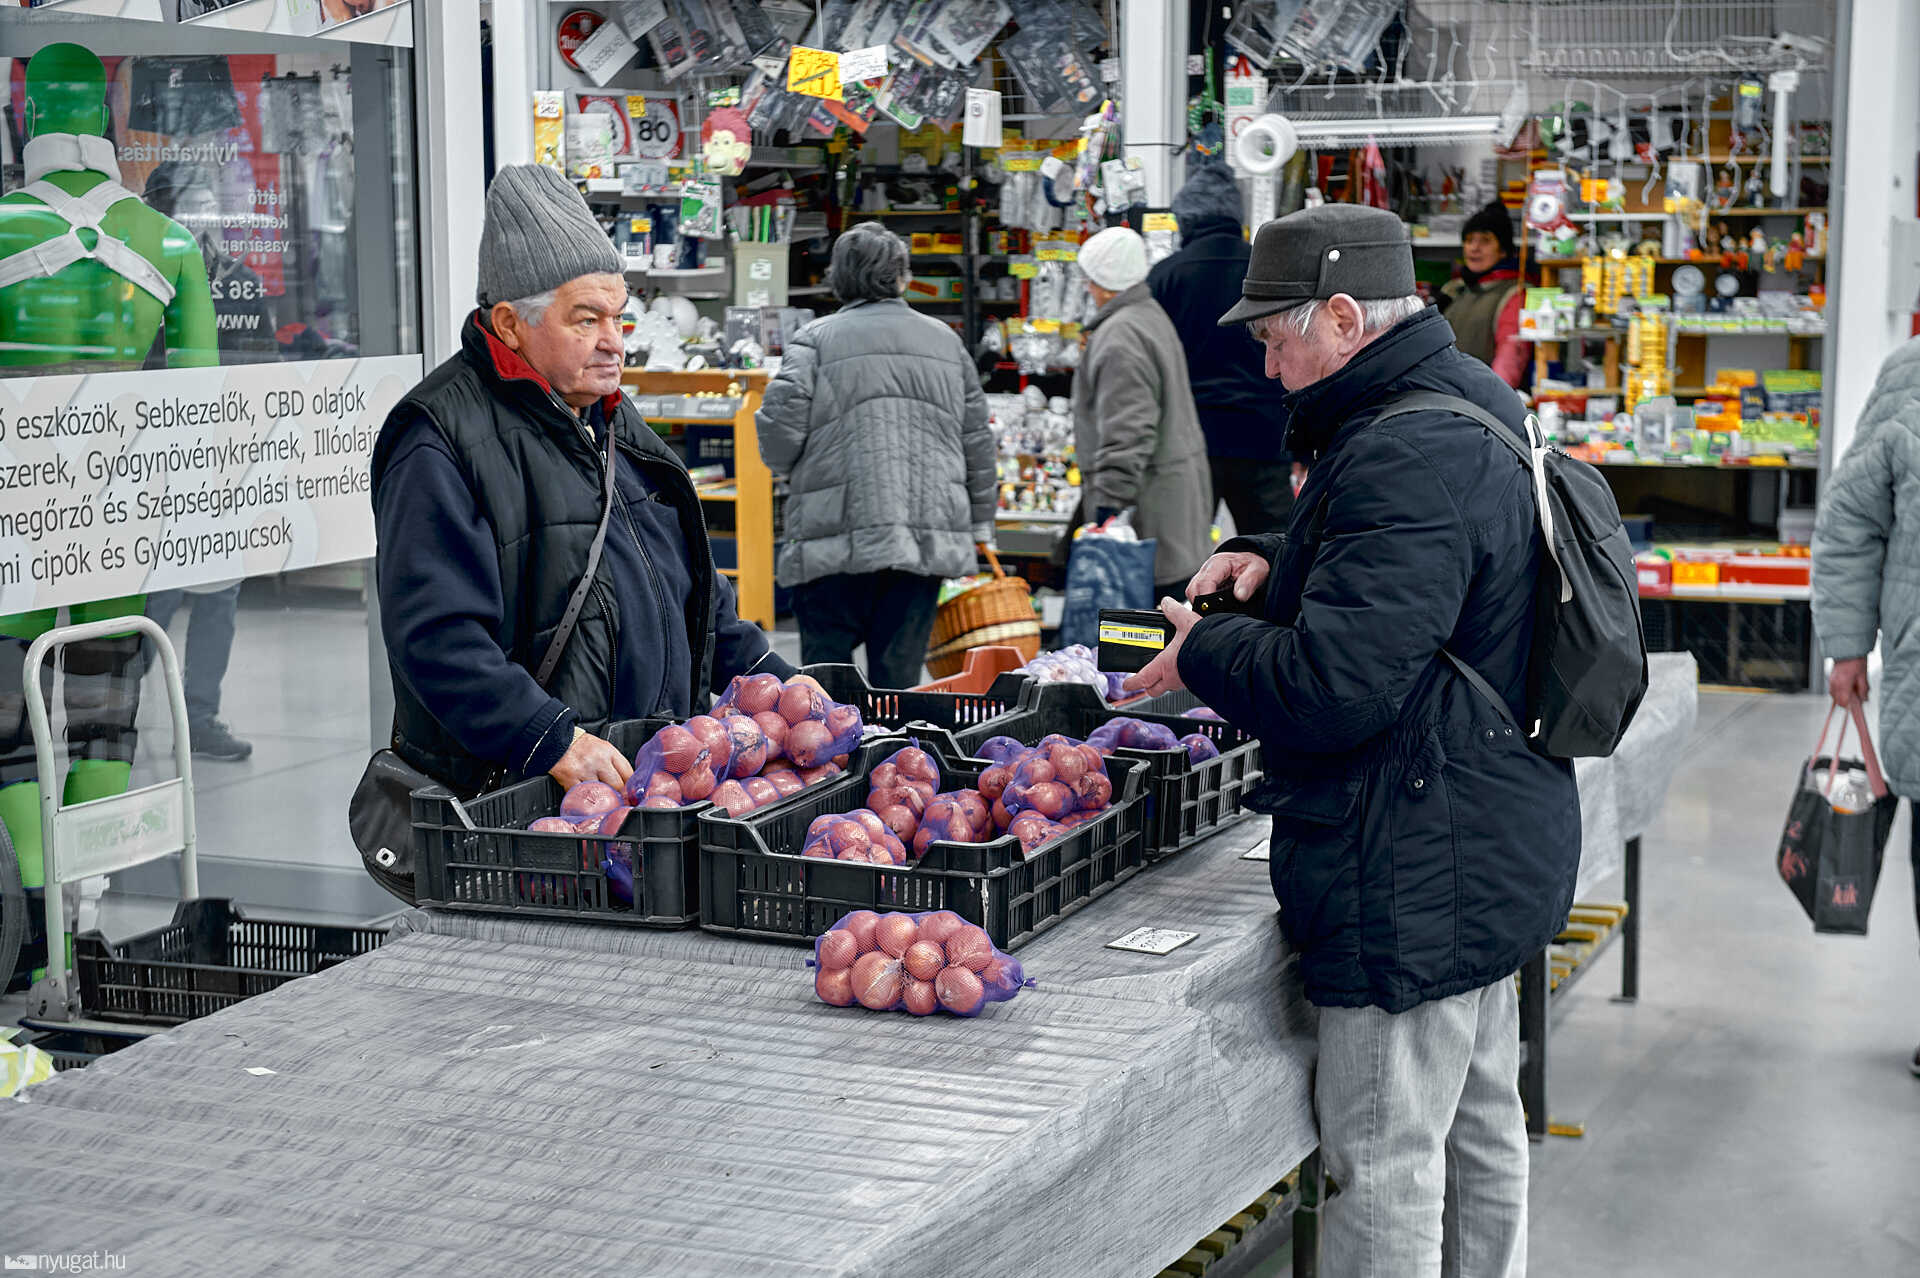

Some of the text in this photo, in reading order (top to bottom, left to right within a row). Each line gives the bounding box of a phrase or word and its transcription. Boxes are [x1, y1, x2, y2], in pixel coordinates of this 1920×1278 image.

[639, 120, 671, 142] 80
[17, 403, 125, 440] eszközök,
[136, 391, 256, 430] Sebkezelők,
[265, 390, 305, 419] CBD
[312, 385, 366, 417] olajok
[87, 431, 306, 485] Gyógynövénykrémek,
[103, 496, 128, 524] és
[137, 474, 288, 521] Szépségápolási
[32, 543, 91, 585] cipők
[101, 538, 125, 570] és
[135, 517, 293, 570] Gyógypapucsok
